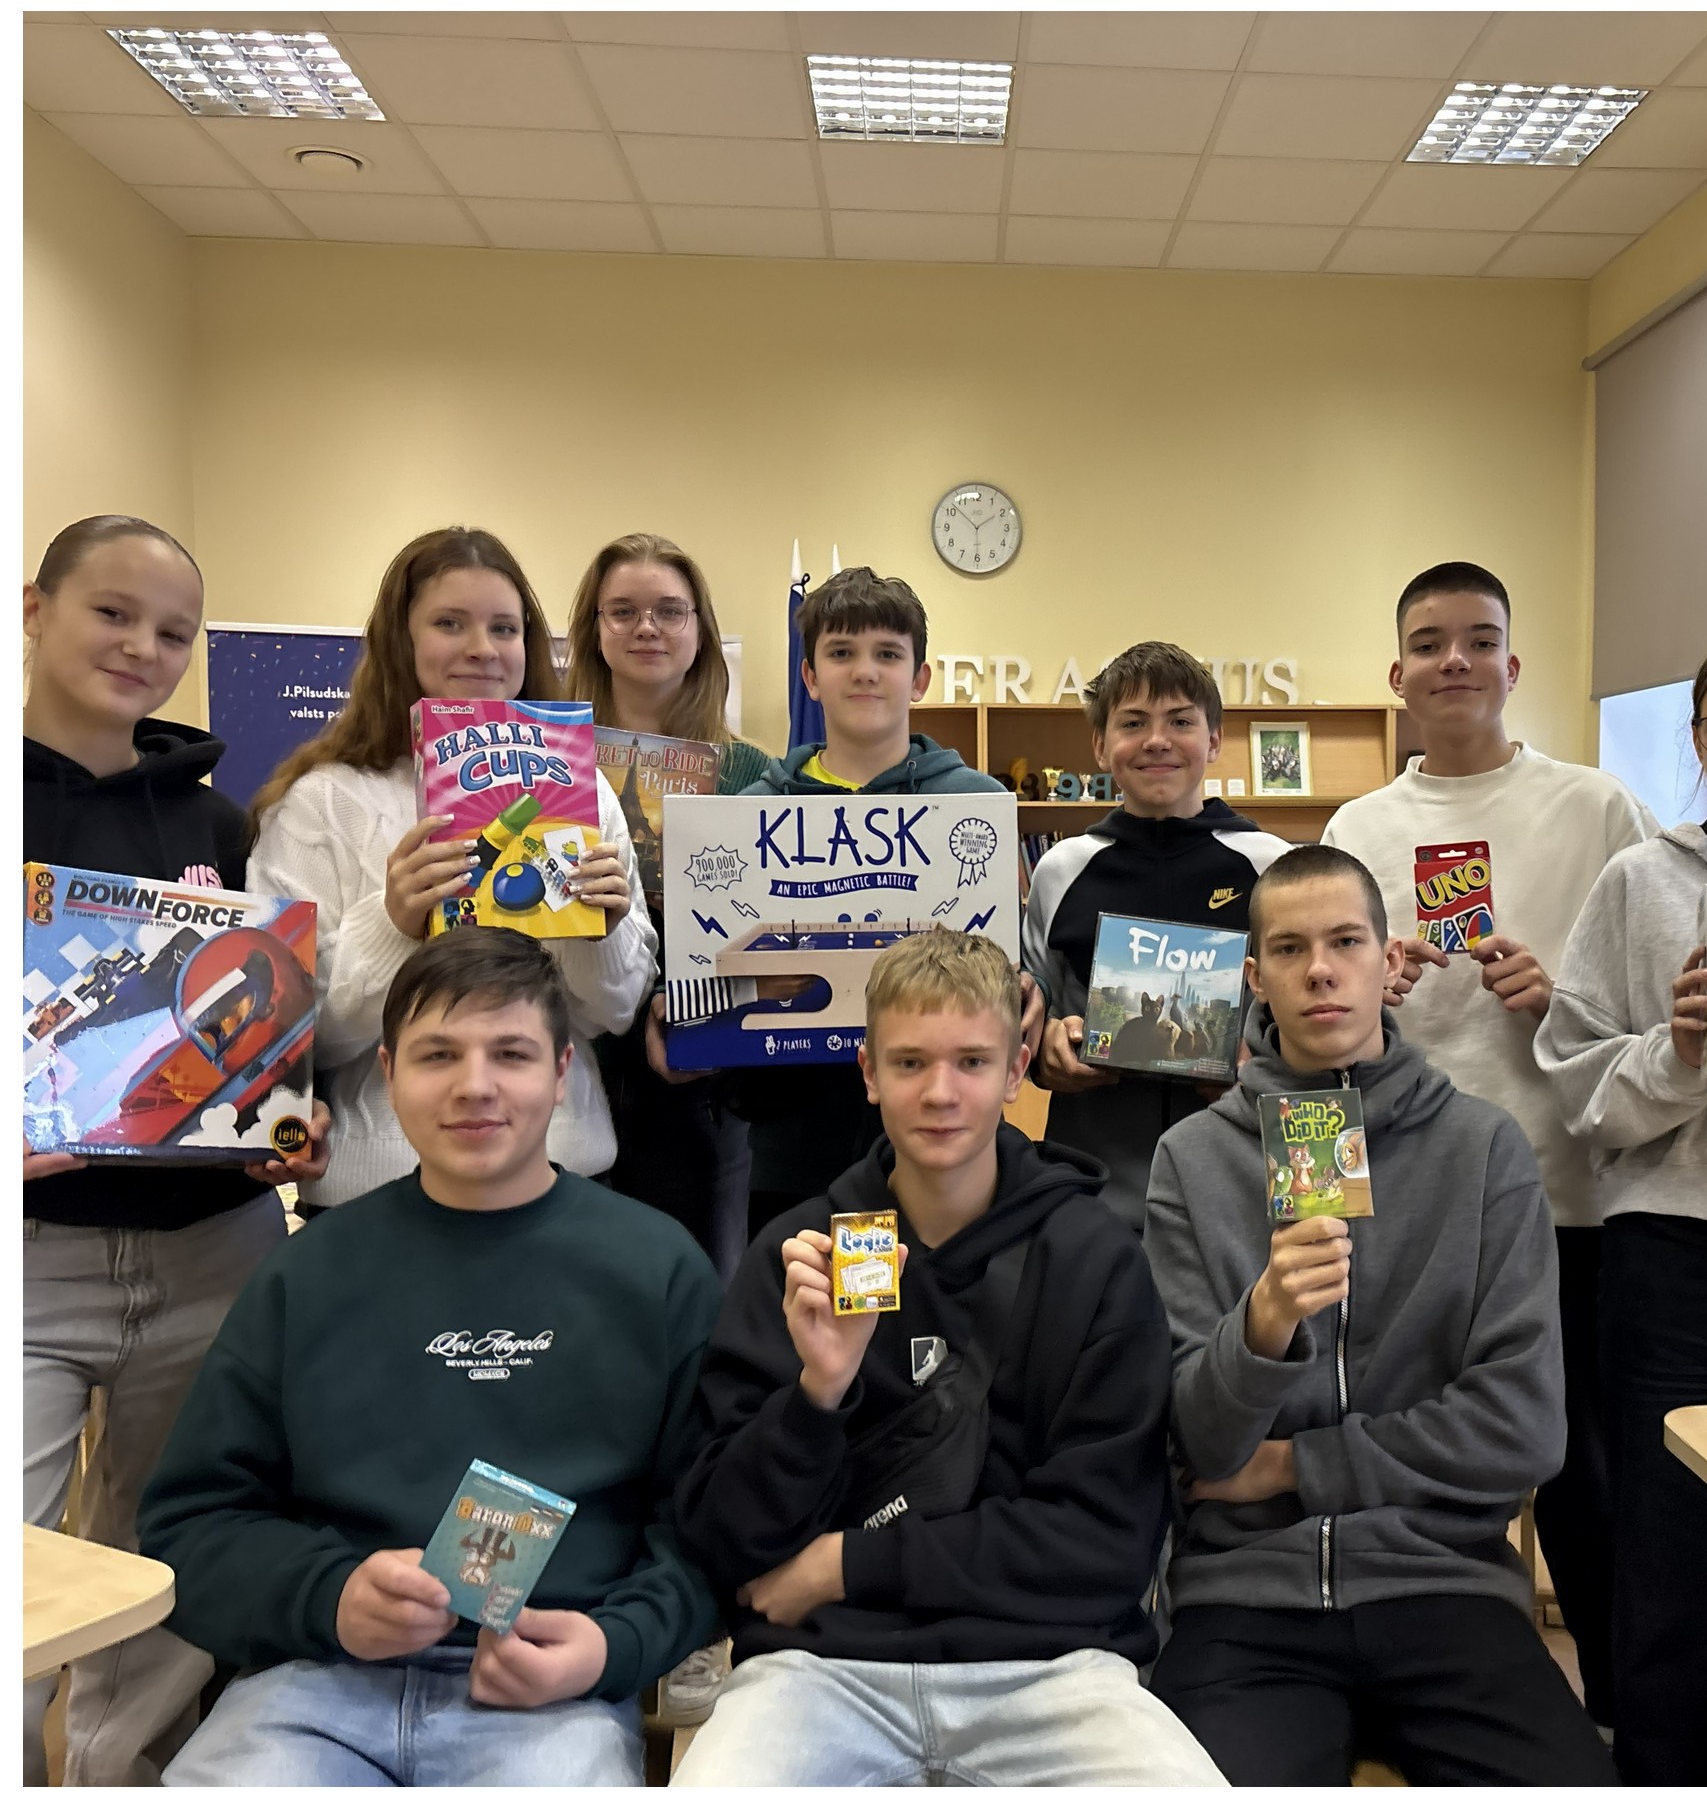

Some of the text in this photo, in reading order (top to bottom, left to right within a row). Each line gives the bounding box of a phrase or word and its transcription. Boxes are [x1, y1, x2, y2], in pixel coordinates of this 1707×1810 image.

[290, 705, 325, 720] valsts
[430, 705, 476, 715] Haim Shafir
[435, 722, 546, 766] HALLI
[459, 748, 572, 792] Cups
[664, 748, 712, 775] RIDE
[639, 772, 698, 794] Paris
[755, 806, 931, 869] KLASK
[696, 871, 718, 882] GAMES
[776, 874, 911, 896] AN EPIC MAGNETIC BATTLE!
[1417, 858, 1492, 911] UNO
[1128, 927, 1216, 972] Flow
[783, 1040, 811, 1050] PLAYERS
[839, 1227, 893, 1255] Logic
[472, 1330, 554, 1358] Angeles
[446, 1359, 479, 1368] BEVERLY
